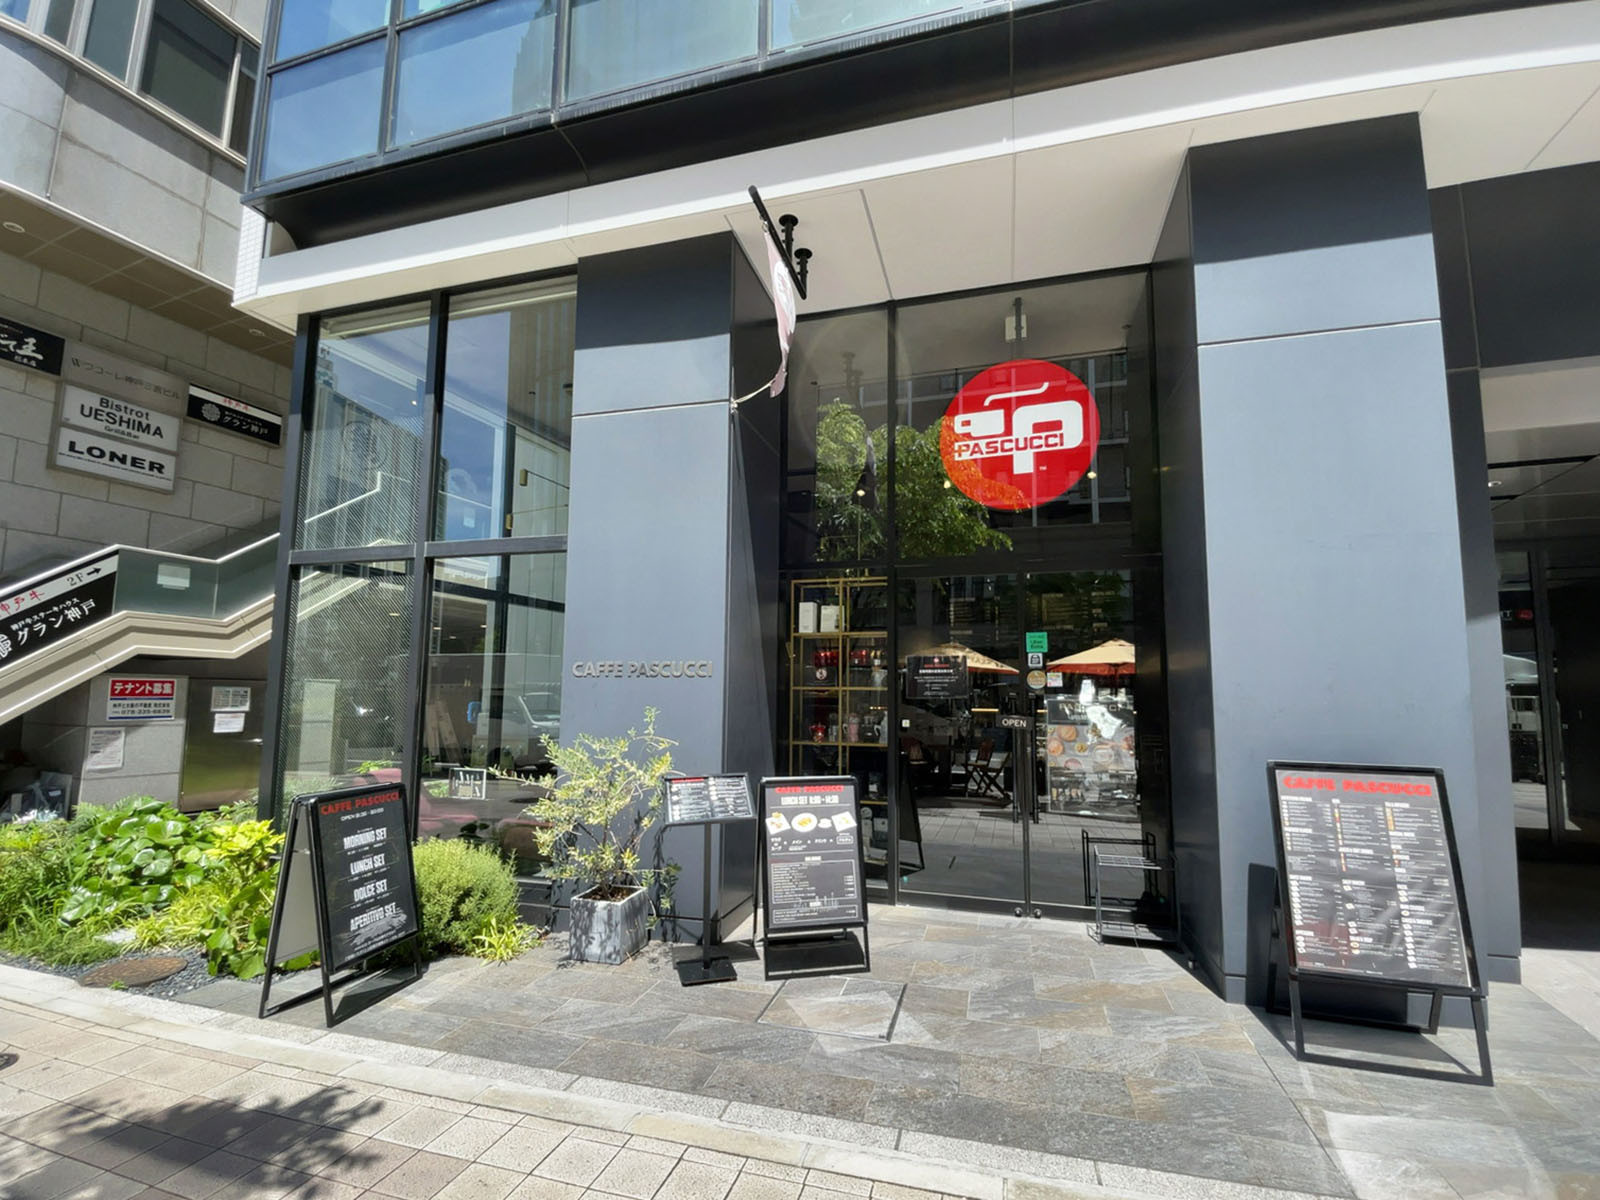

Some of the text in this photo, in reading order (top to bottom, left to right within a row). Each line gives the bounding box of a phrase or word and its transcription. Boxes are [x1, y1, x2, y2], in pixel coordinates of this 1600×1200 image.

[100, 397, 149, 420] Bistrot
[80, 404, 164, 439] UESHIMA
[957, 433, 1064, 457] PASCUCCI
[68, 441, 165, 474] LONER
[66, 572, 84, 586] 2F
[17, 598, 96, 646] グラン神戸
[572, 661, 713, 678] CAFFE PASCUCCI
[113, 682, 173, 695] テナント募集
[1002, 718, 1027, 727] OPEN
[1283, 776, 1432, 796] CAFFE PASCUCCI
[320, 791, 400, 815] CAFFE PASCUCCI
[375, 827, 387, 840] SET
[350, 857, 373, 875] LUNCH
[373, 853, 385, 867] SET
[353, 884, 375, 902] DOLCE
[376, 879, 388, 894] SET
[350, 902, 396, 932] APERITIVO SET
